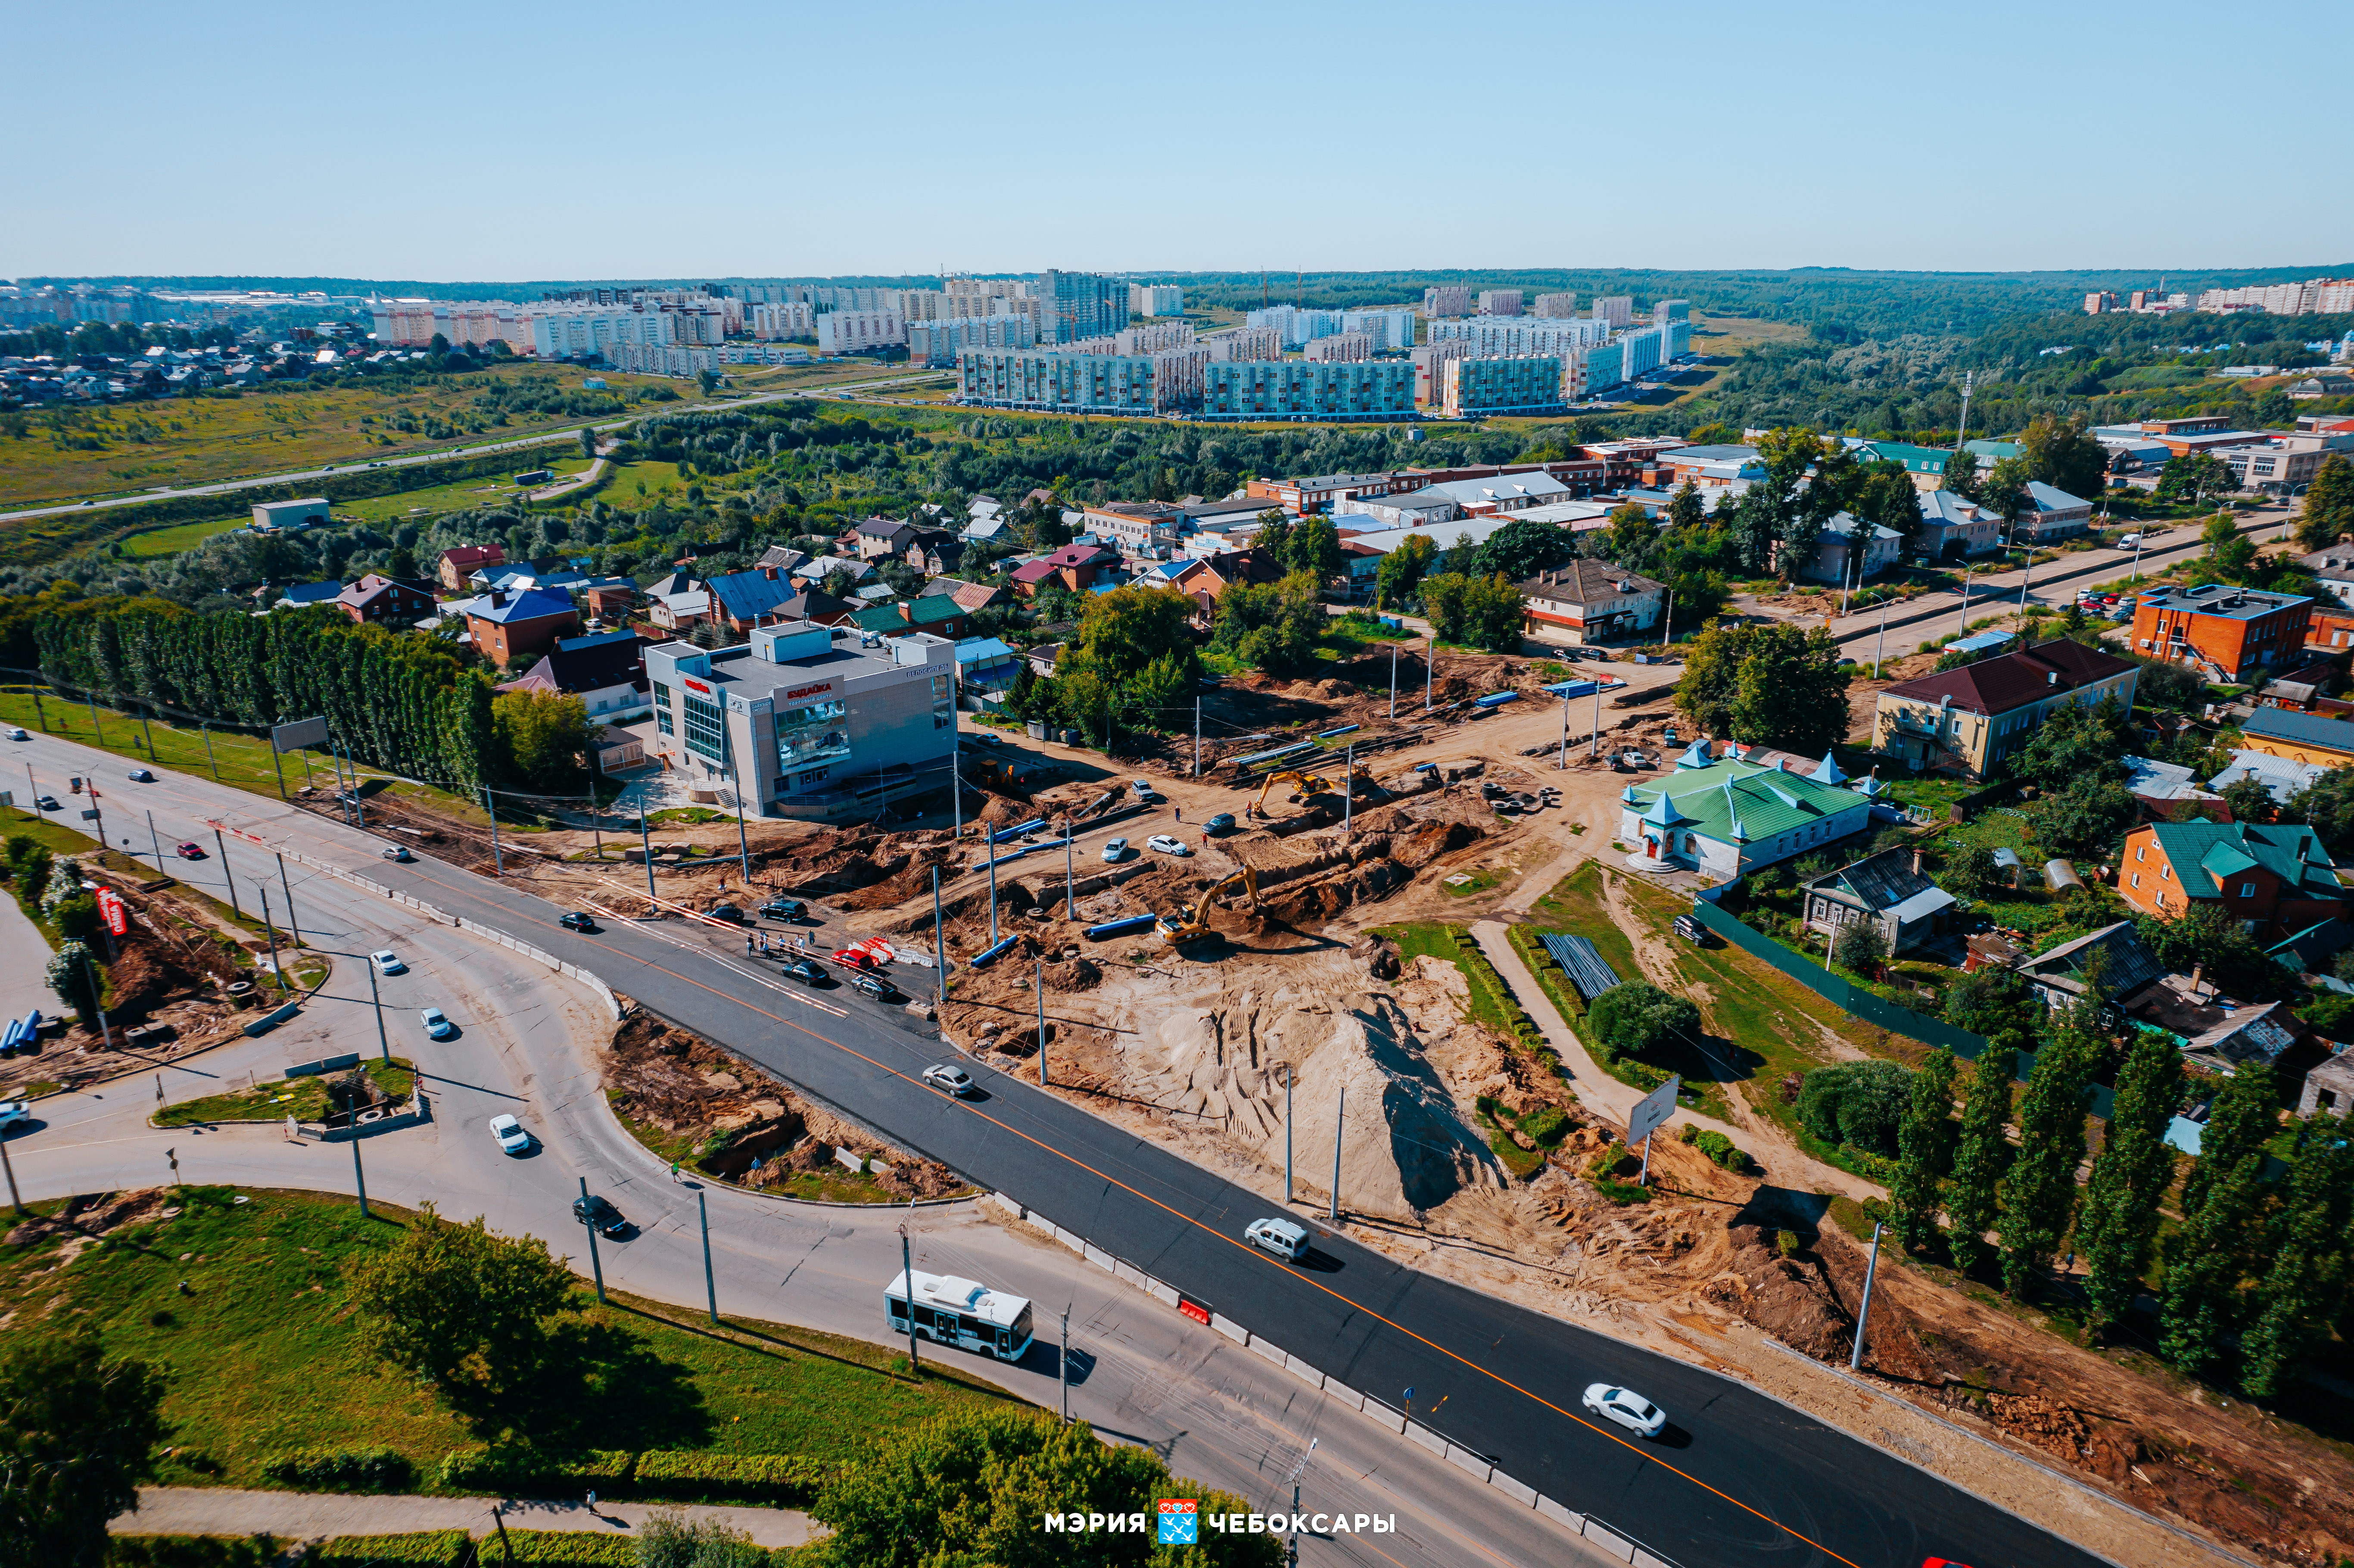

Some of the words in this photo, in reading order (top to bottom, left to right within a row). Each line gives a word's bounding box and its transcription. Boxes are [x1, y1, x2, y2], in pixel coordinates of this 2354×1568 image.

[907, 663, 949, 677] ВЕЛОСИПЕДЫ
[787, 683, 832, 699] БУДАЙКА
[751, 701, 772, 709] DARKSIDE
[788, 697, 815, 706] ТОРГОВЫЙ
